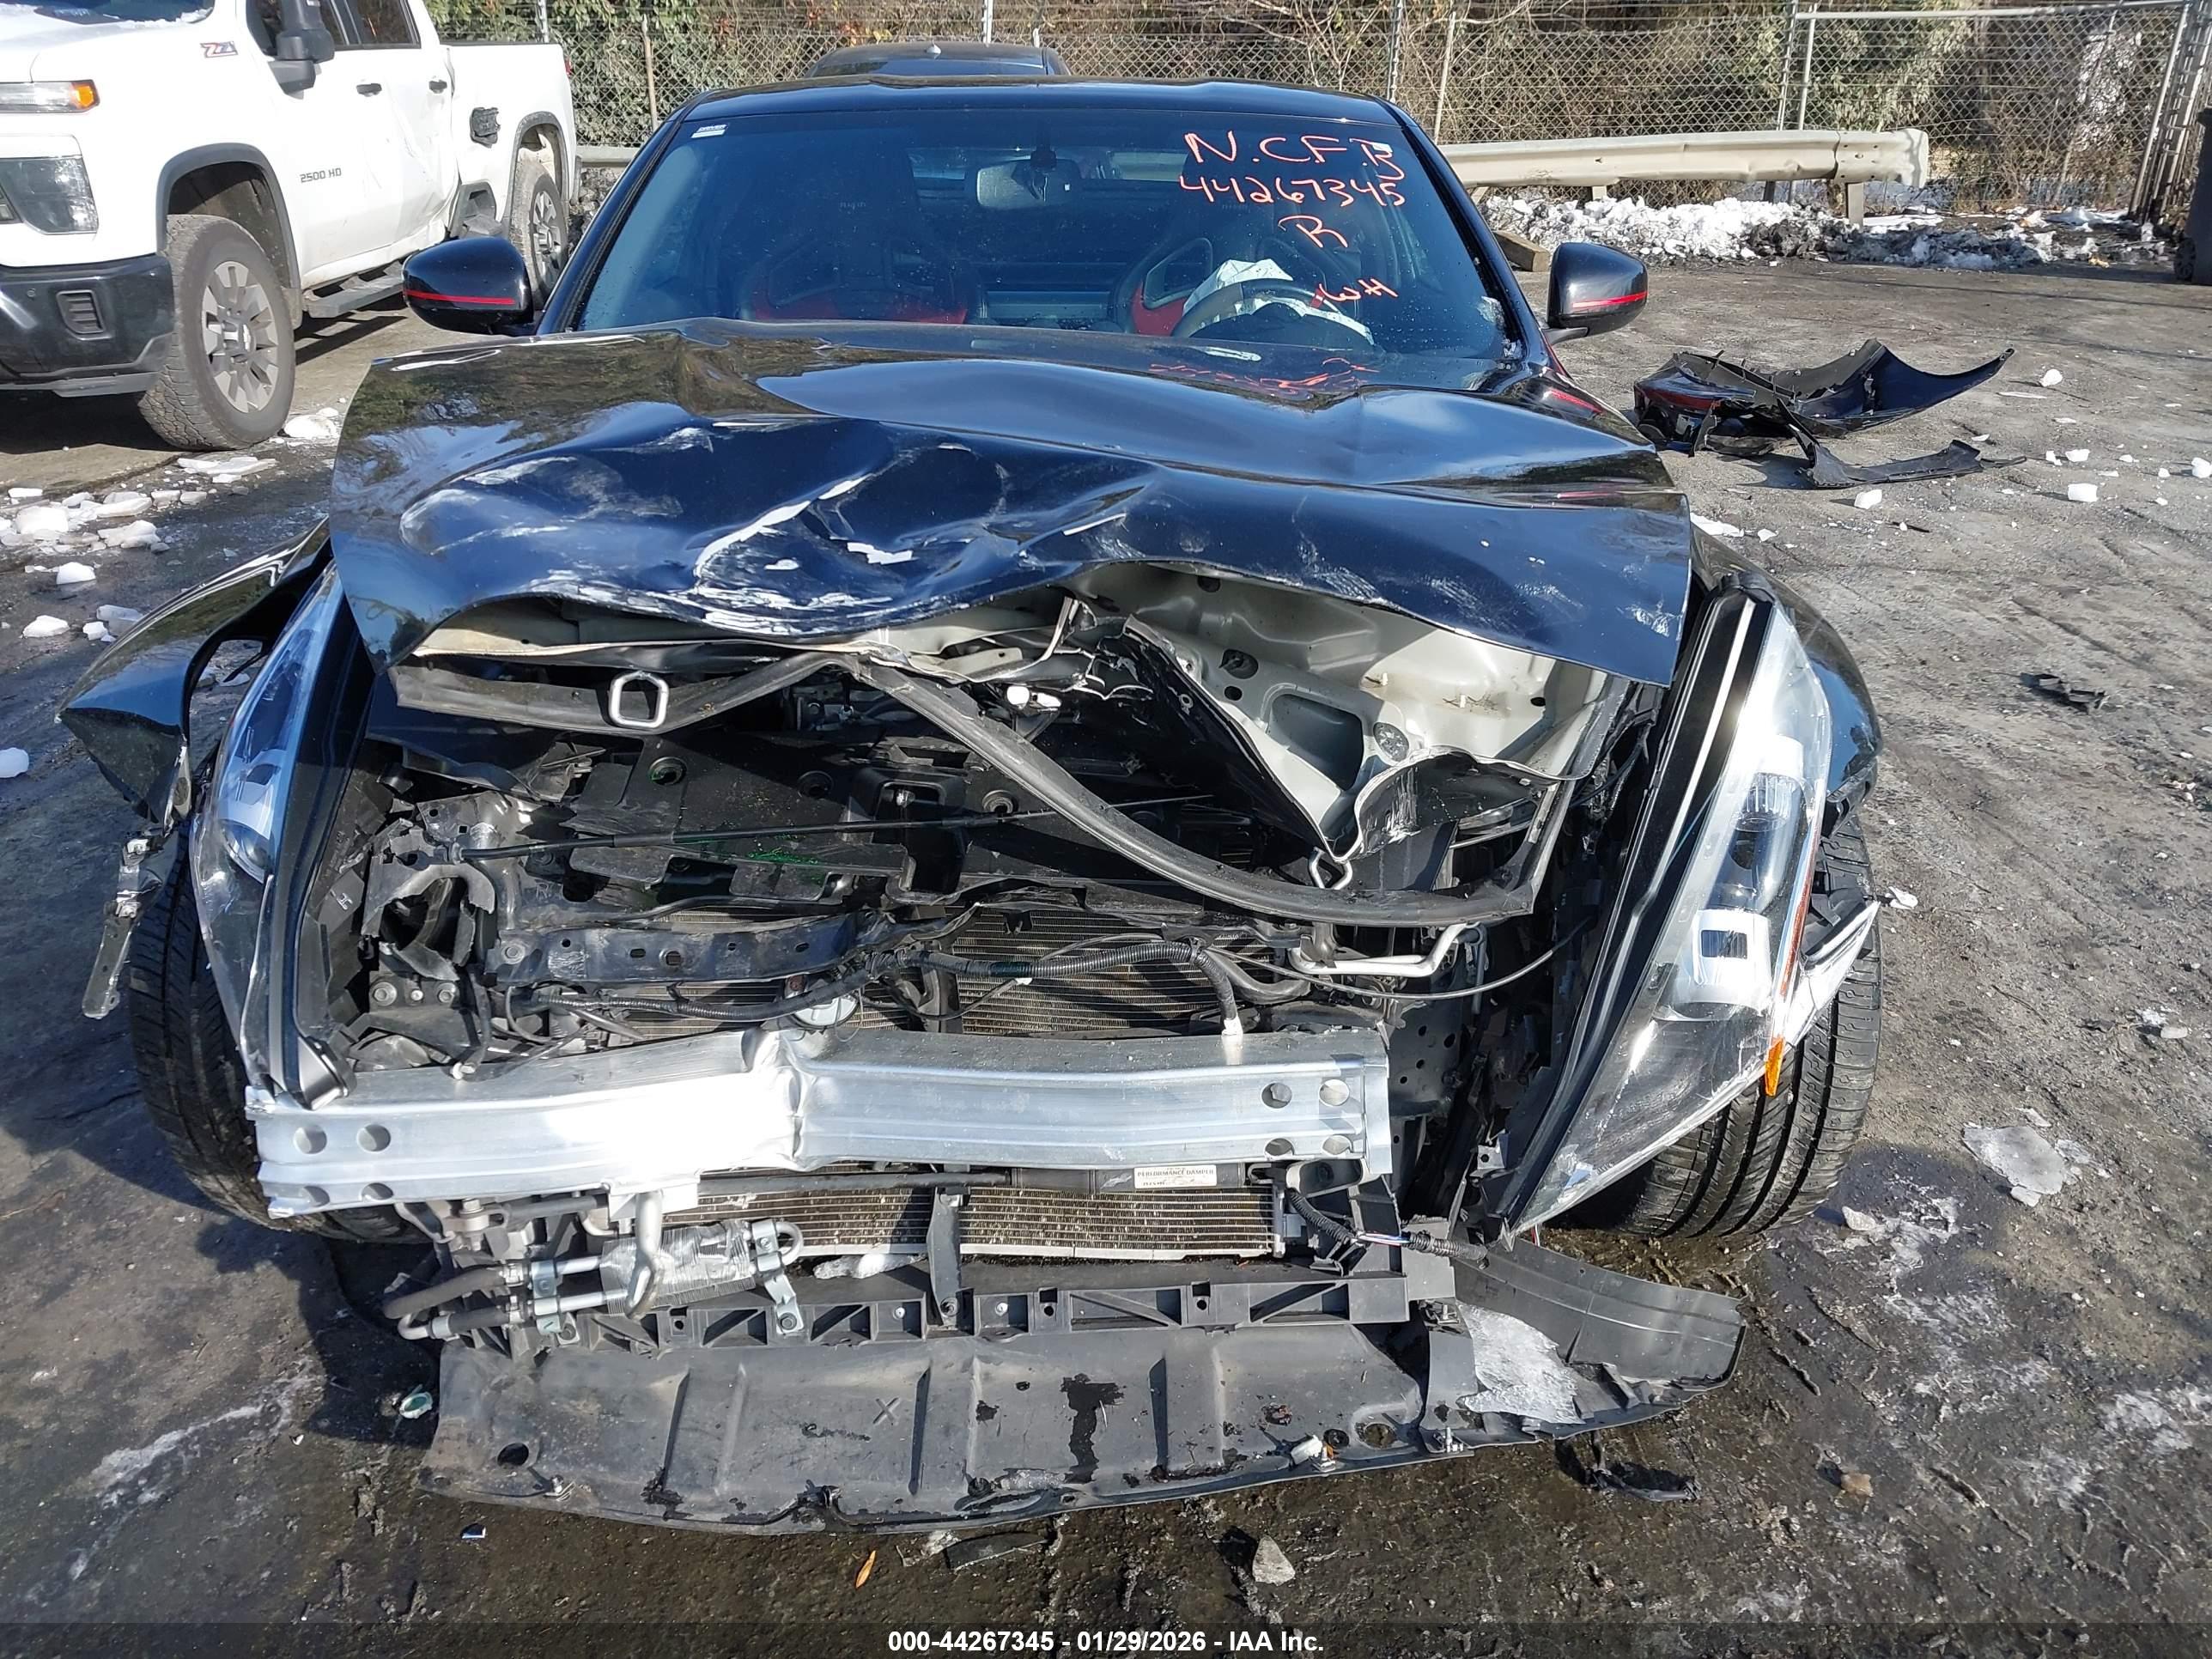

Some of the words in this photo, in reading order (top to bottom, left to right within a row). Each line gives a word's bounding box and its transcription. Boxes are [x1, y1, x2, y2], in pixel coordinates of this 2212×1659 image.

[300, 170, 326, 183] 2500
[328, 167, 342, 178] HD
[1179, 175, 1405, 207] 44267345
[1137, 1169, 1185, 1177] PERFORMANCE
